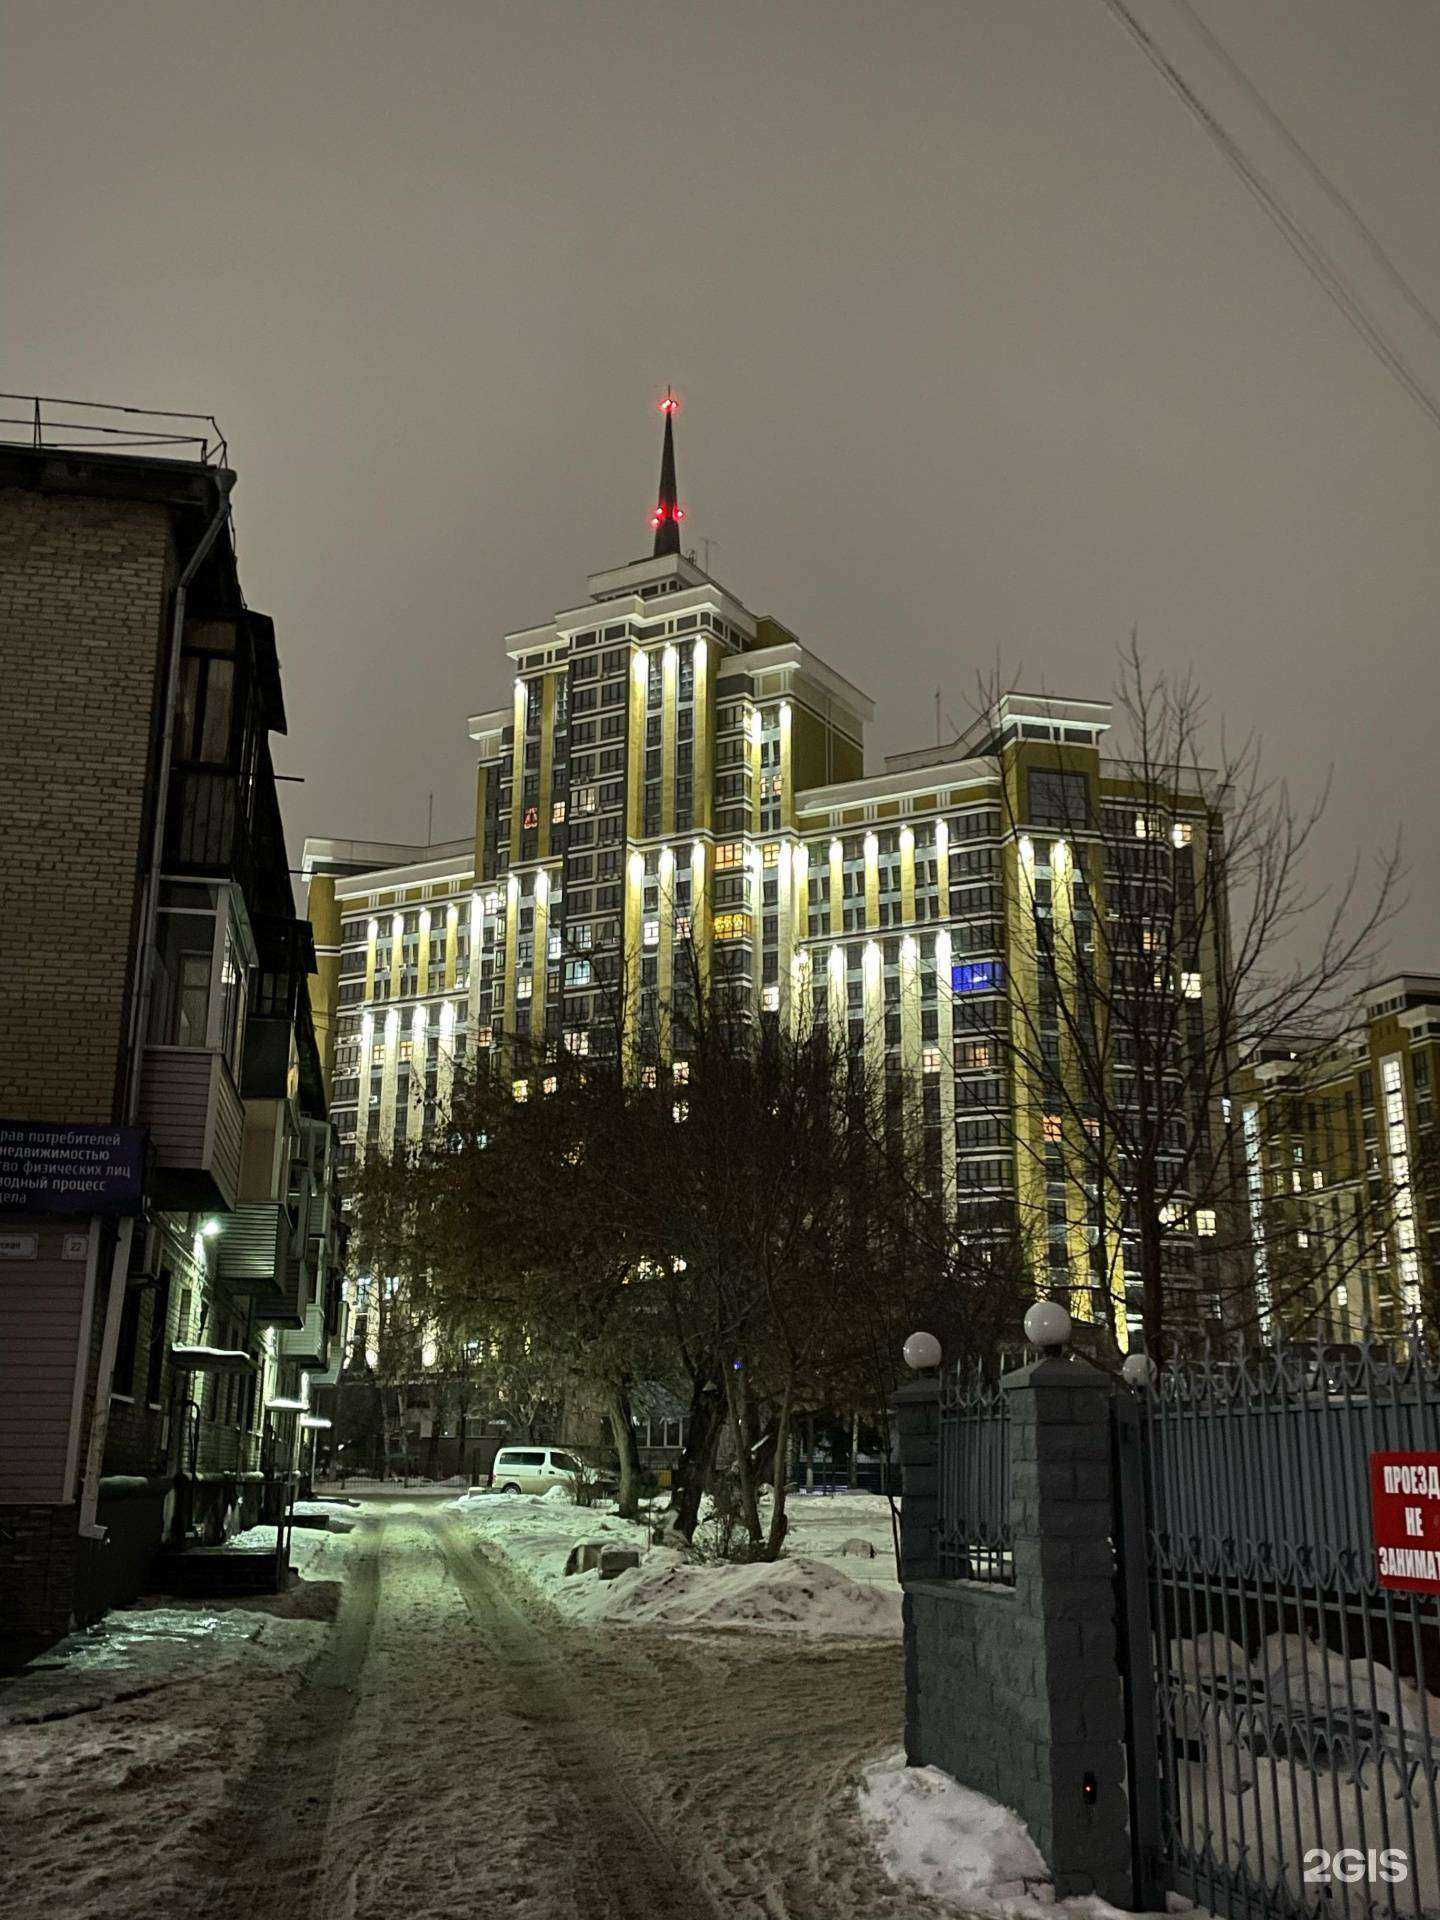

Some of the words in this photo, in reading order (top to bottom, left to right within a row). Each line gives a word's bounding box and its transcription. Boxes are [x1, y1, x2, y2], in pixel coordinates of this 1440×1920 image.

[28, 1131, 121, 1146] потребителей
[0, 1145, 110, 1161] недвижимостью
[23, 1160, 102, 1176] физических
[105, 1165, 131, 1179] лиц
[52, 1180, 106, 1193] процесс
[1383, 1465, 1440, 1500] ПРОЕЗД
[1405, 1507, 1424, 1537] НЕ
